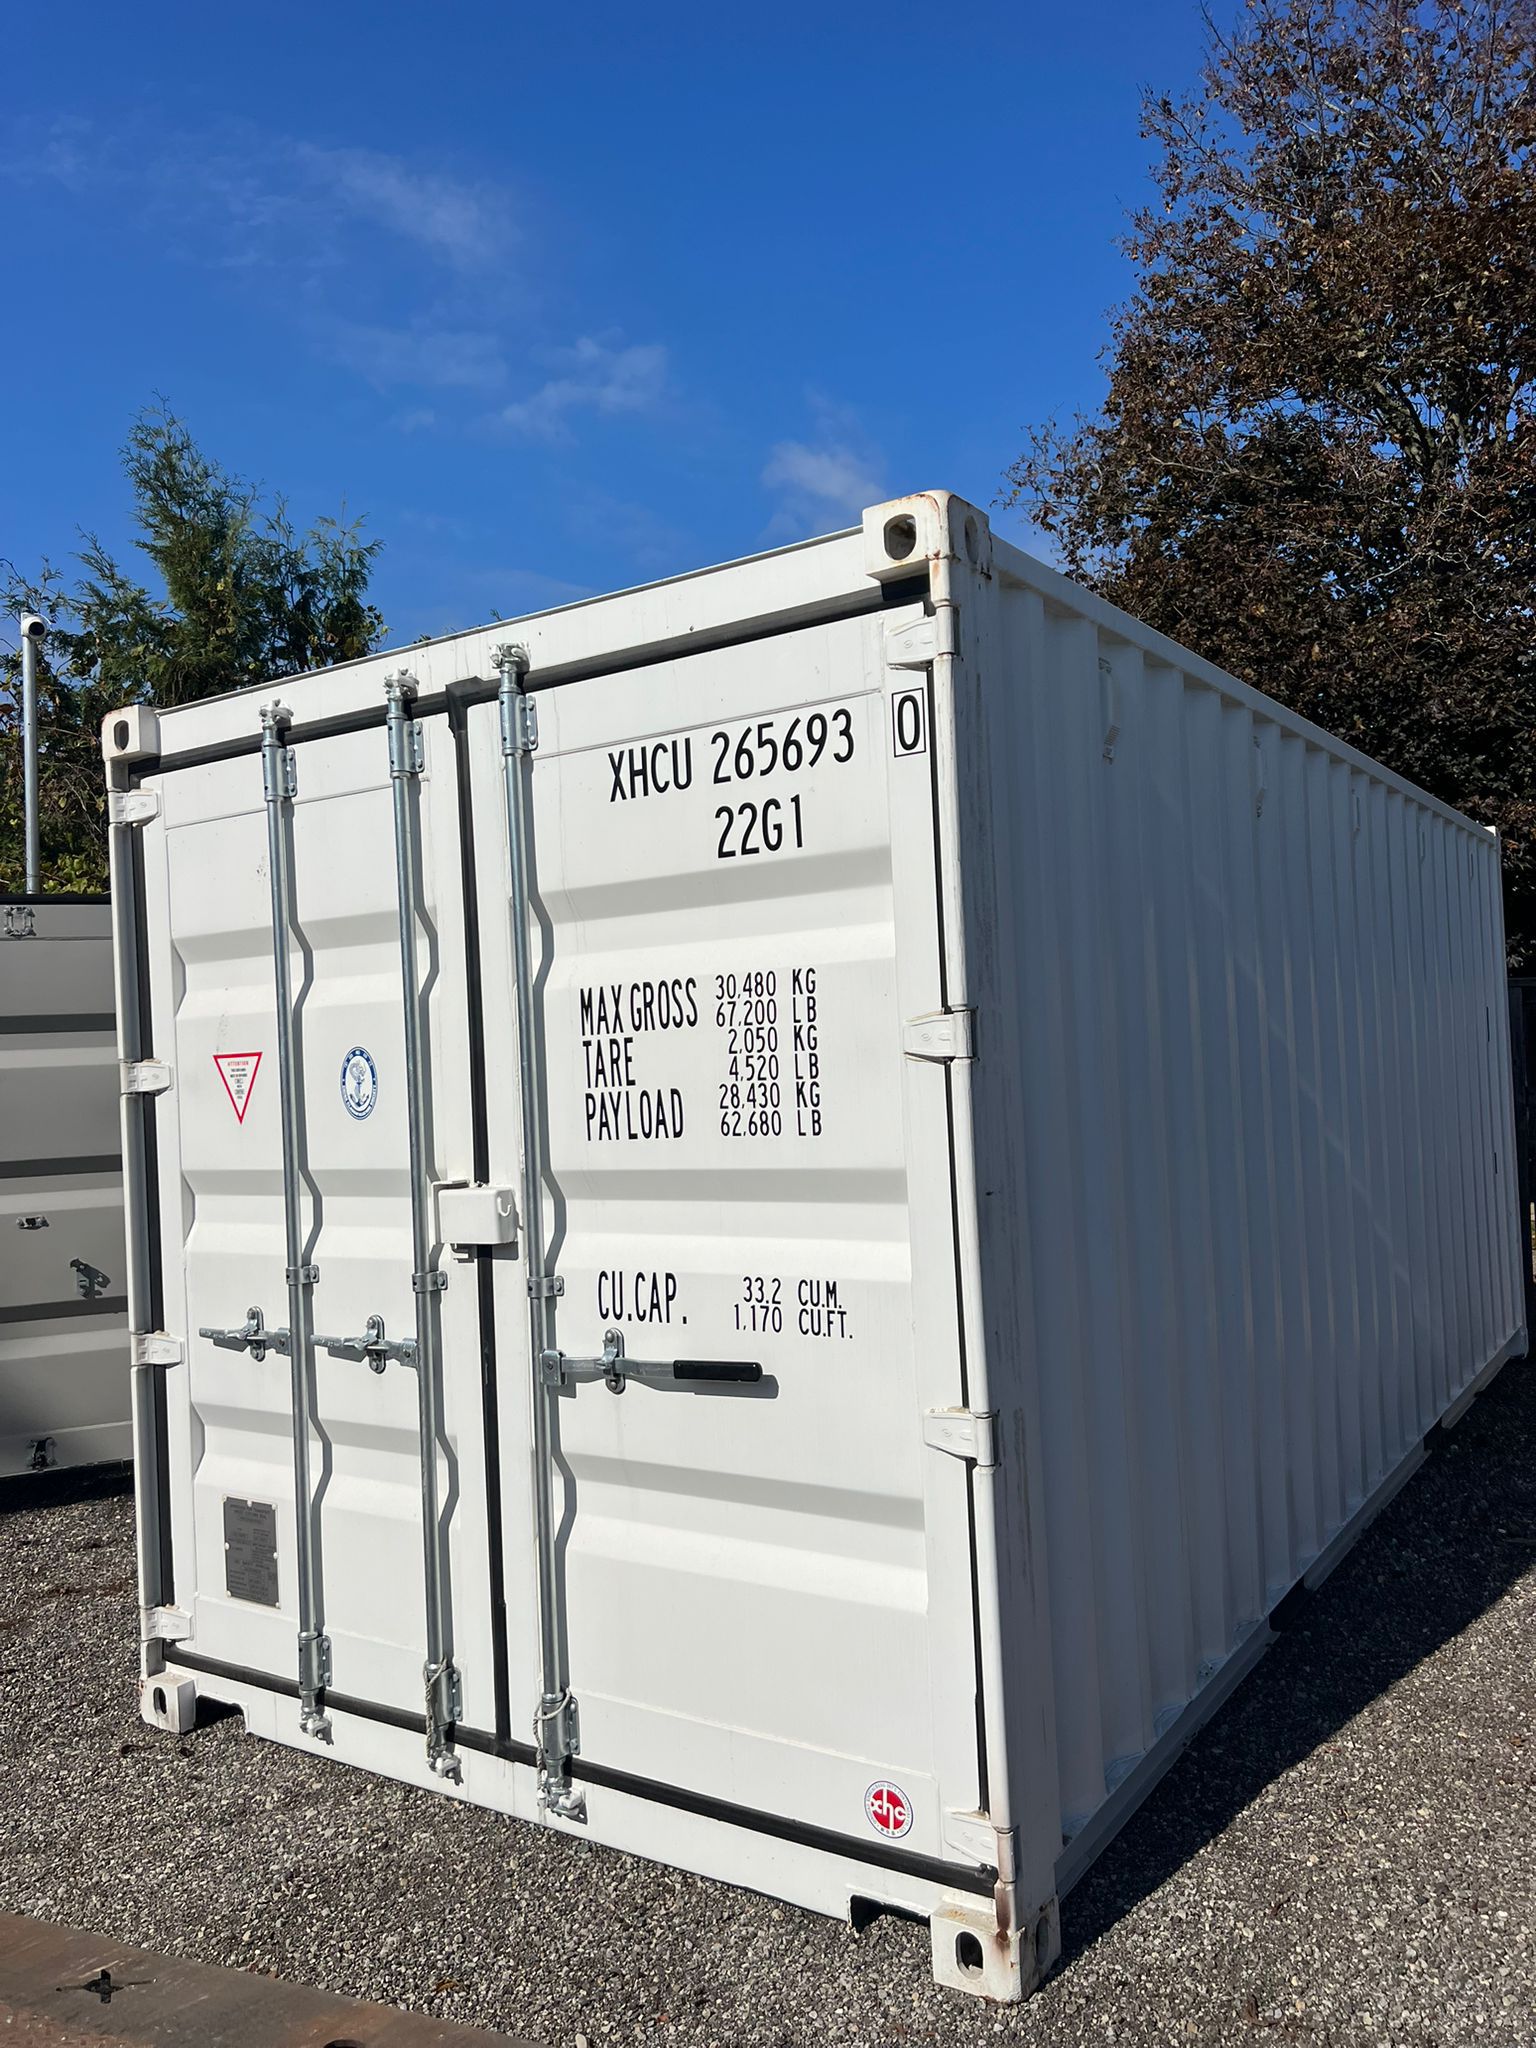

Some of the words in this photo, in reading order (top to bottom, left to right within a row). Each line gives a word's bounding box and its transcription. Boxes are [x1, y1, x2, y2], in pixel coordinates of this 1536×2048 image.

[608, 737, 692, 802] XHCU
[711, 708, 854, 785] 265693
[897, 694, 921, 751] 0
[715, 794, 803, 859] 22G1
[580, 984, 624, 1036] MAX
[630, 977, 698, 1032] GROSS
[715, 971, 777, 1000] 30,480
[792, 968, 817, 996] KG
[716, 999, 778, 1028] 67,200
[792, 996, 817, 1024] LB
[582, 1037, 636, 1089] TARE
[728, 1027, 778, 1054] 2,050
[793, 1024, 818, 1051] KG
[729, 1054, 779, 1081] 4,520
[795, 1053, 819, 1080] LB
[585, 1088, 684, 1141] PAYLOAD
[719, 1082, 780, 1109] 28,430
[796, 1081, 821, 1109] KG
[720, 1110, 782, 1137] 62,680
[797, 1109, 822, 1137] LB
[743, 1276, 782, 1305] 33.2
[734, 1303, 782, 1333] 1,170
